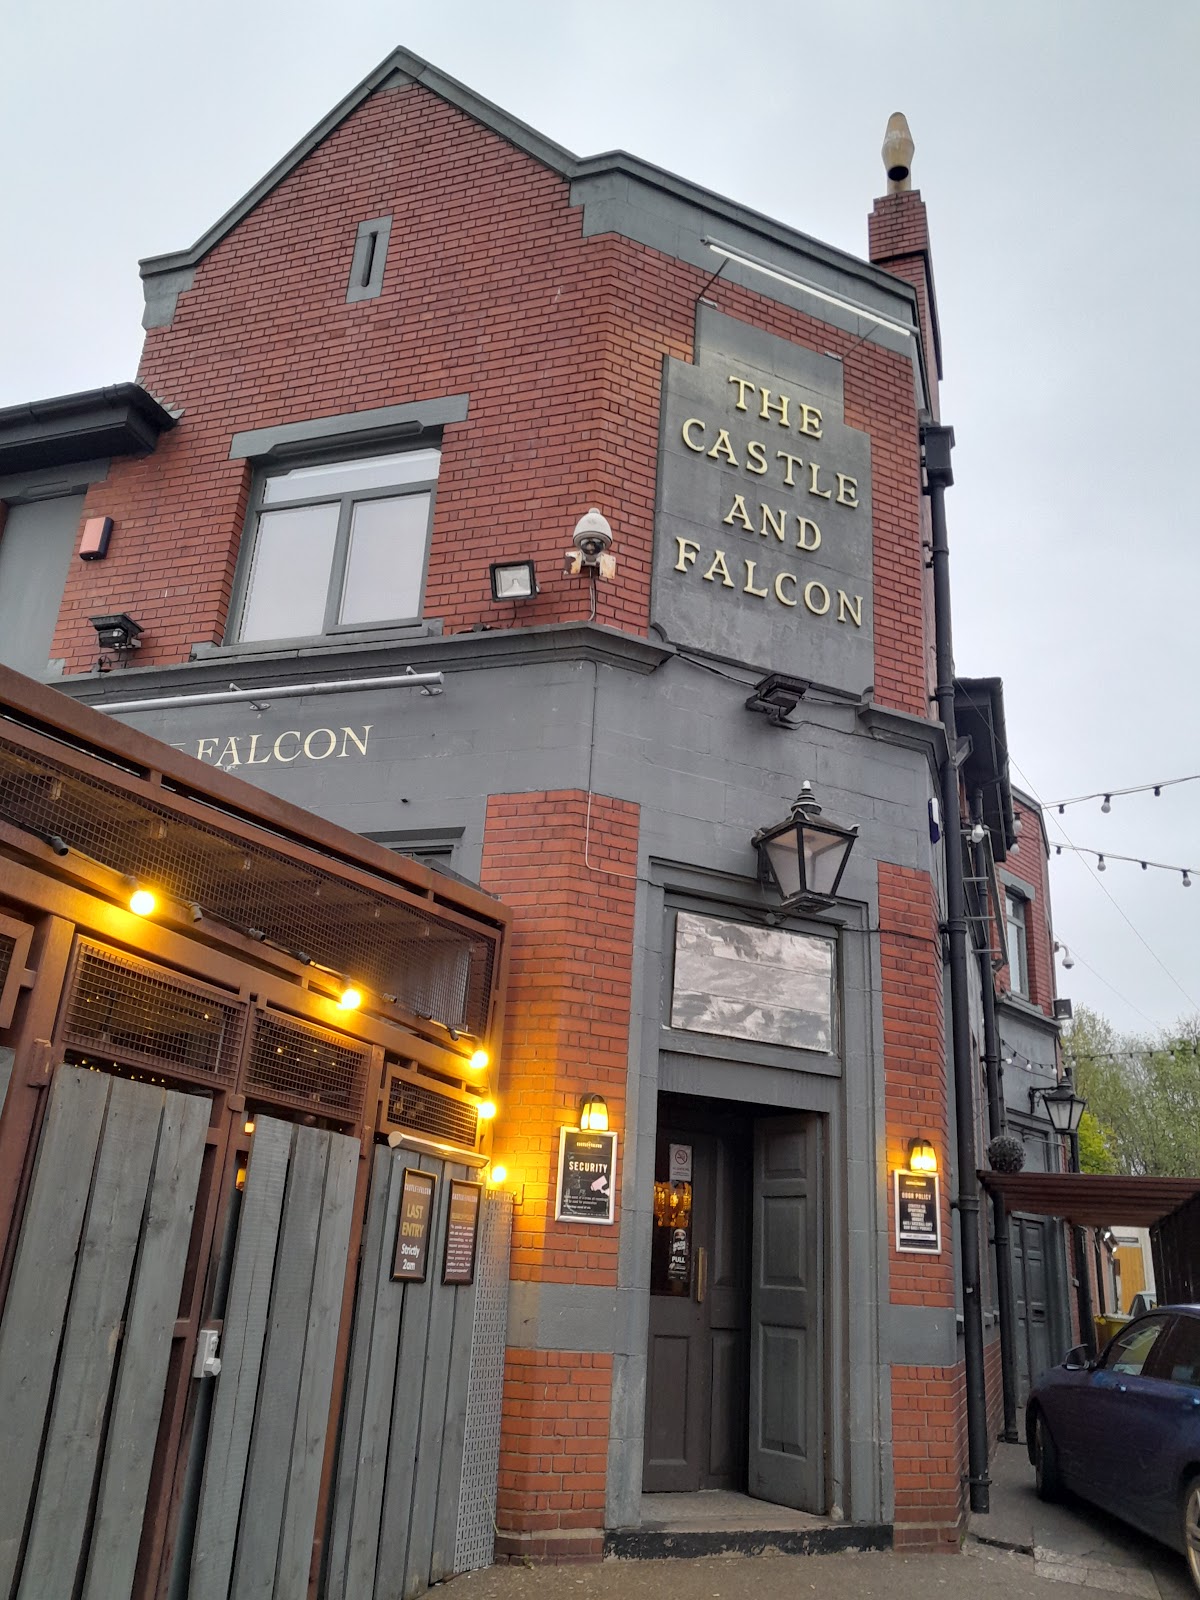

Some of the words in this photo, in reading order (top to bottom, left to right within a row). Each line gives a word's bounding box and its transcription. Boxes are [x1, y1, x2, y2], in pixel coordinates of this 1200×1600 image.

[728, 375, 823, 439] THE
[681, 418, 859, 508] CASTLE
[723, 494, 822, 551] AND
[674, 536, 863, 627] FALCON
[196, 725, 374, 767] FALCON
[568, 1161, 608, 1173] SECURITY
[915, 1192, 931, 1200] POLICY
[407, 1204, 423, 1219] LAST
[402, 1222, 424, 1238] ENTRY
[401, 1243, 420, 1258] Strictly
[402, 1259, 415, 1271] 2am
[671, 1255, 686, 1264] PULL
